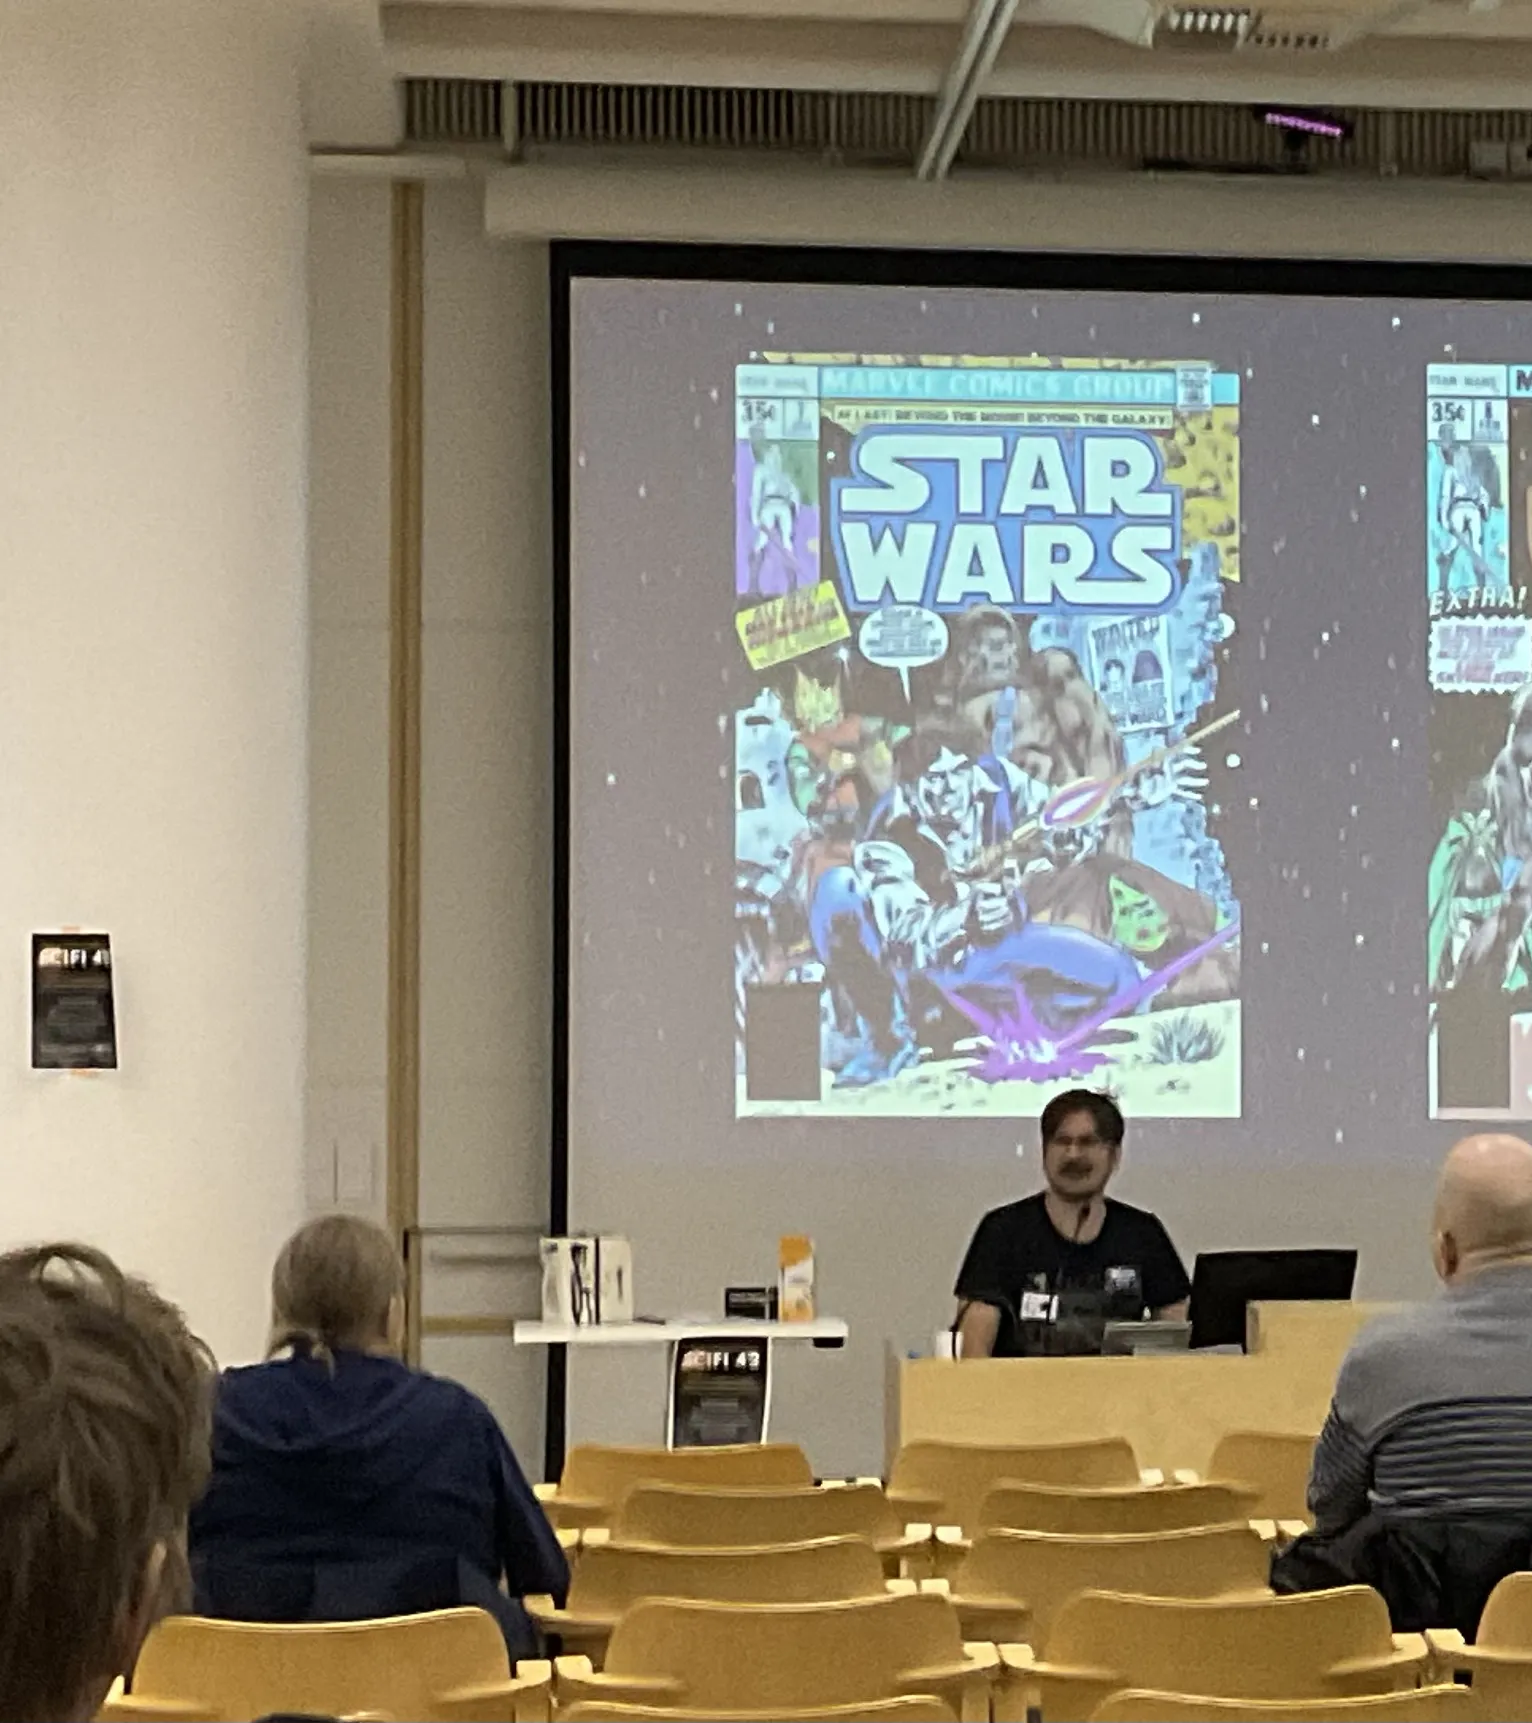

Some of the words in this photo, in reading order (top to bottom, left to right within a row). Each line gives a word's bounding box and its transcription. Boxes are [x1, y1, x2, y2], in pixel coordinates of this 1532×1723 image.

[951, 373, 1061, 397] COMICS
[1073, 375, 1173, 400] GROUP
[840, 435, 1172, 516] STAR
[840, 521, 1172, 604] WARS
